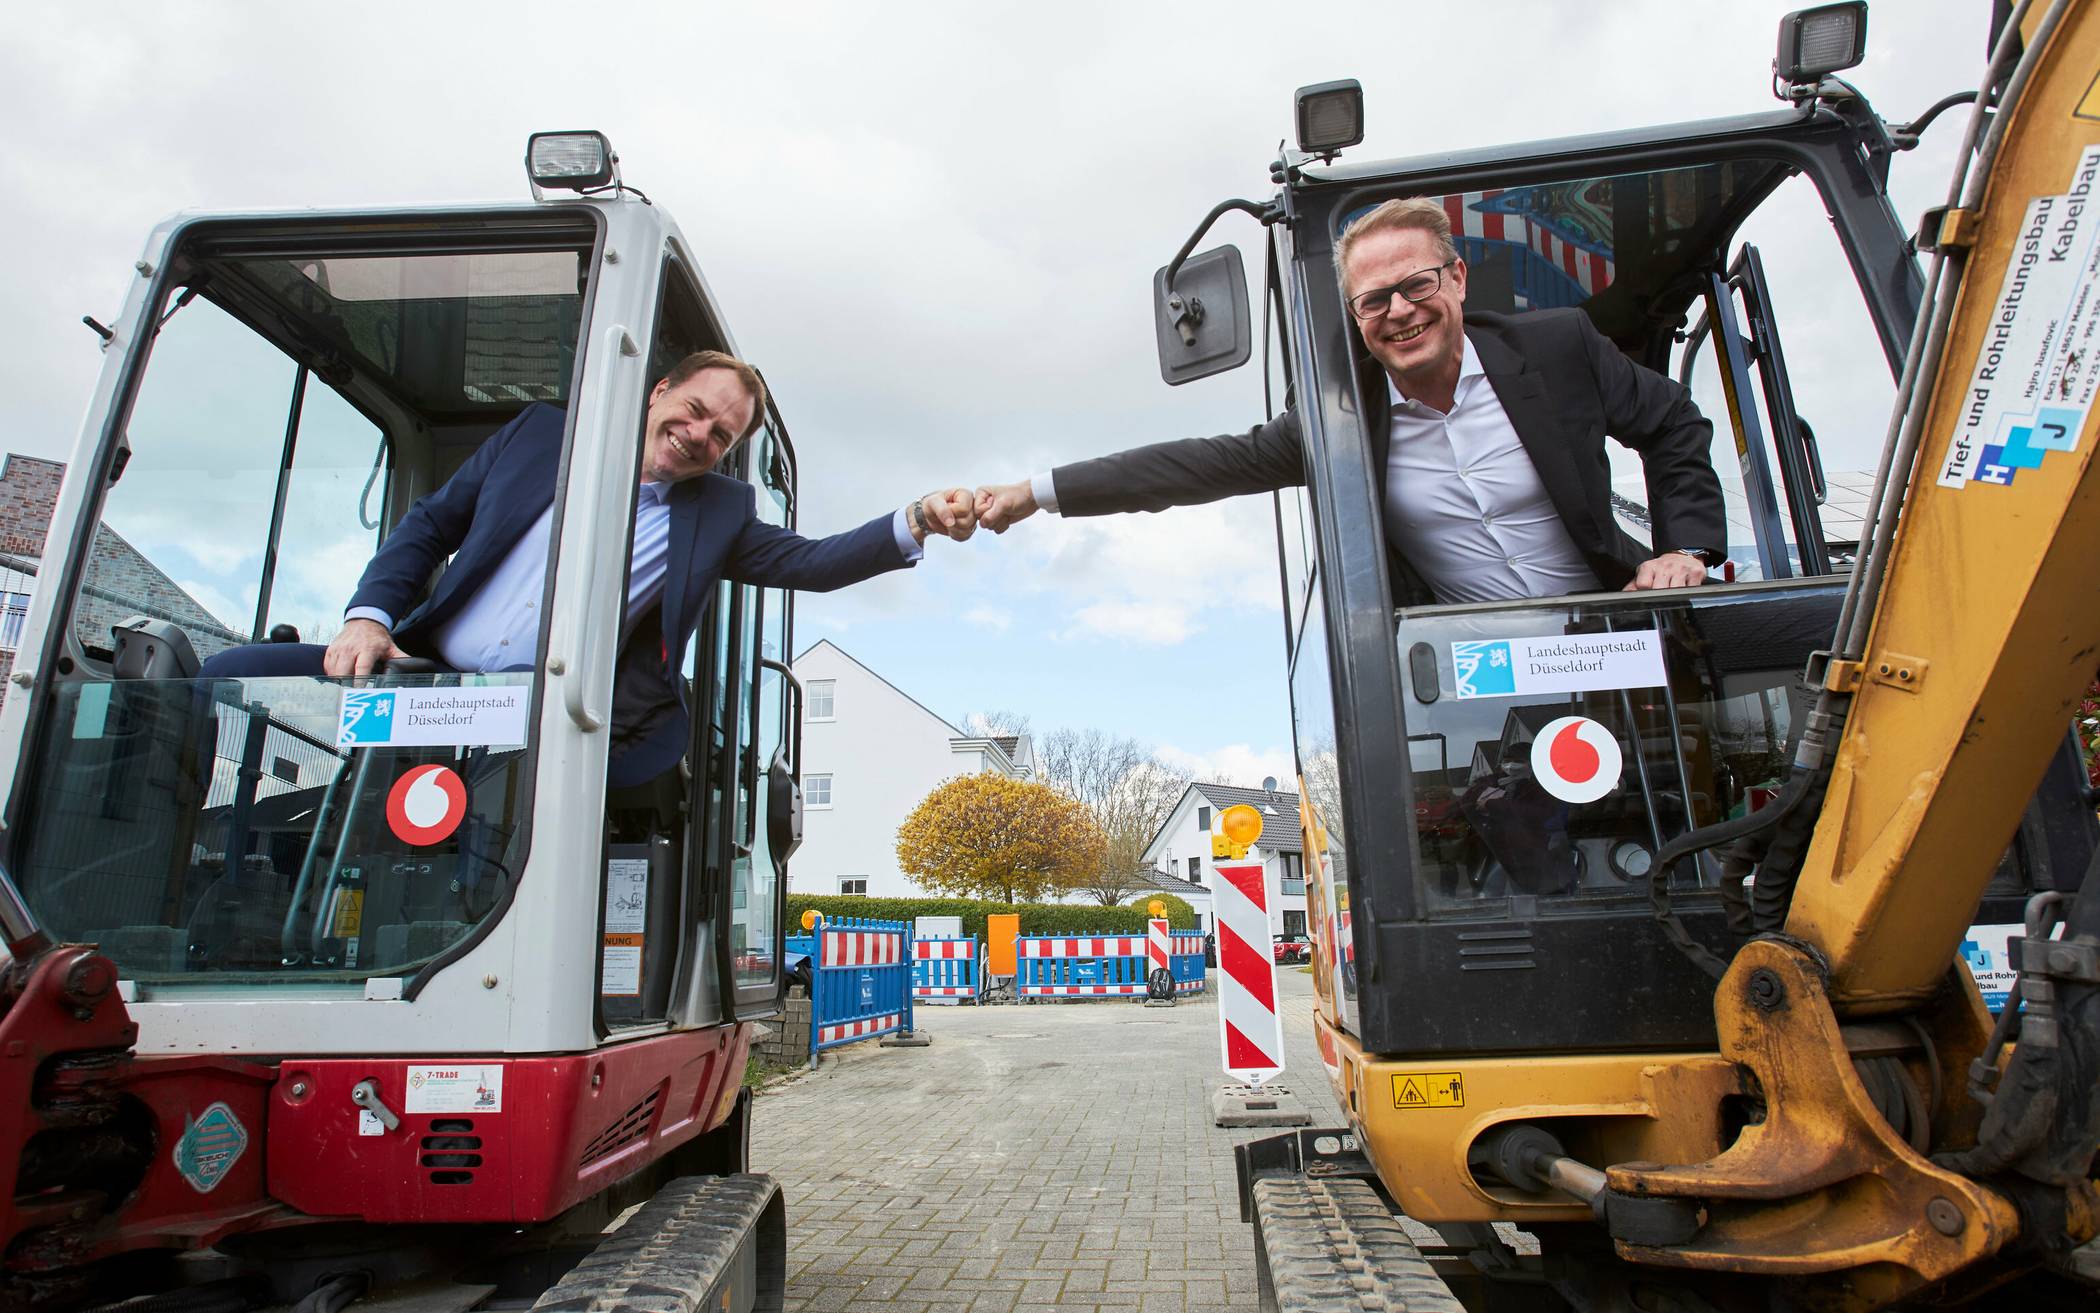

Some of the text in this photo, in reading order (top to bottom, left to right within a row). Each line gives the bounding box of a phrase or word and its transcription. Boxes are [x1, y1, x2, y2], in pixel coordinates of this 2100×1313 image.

[2048, 154, 2100, 262] Kabelbau
[1945, 198, 2054, 480] Tief- und Rohrleitungsbau
[2024, 319, 2058, 398] Hajro Jusufovic
[1980, 423, 2067, 484] H J
[1527, 639, 1647, 658] Landeshauptstadt
[1529, 658, 1605, 676] Düsseldorf
[409, 696, 516, 712] Landeshauptstadt
[408, 713, 475, 726] Düsseldorf
[605, 937, 632, 945] NUNG
[1977, 954, 1985, 966] J
[427, 1071, 460, 1079] 7-TRADE
